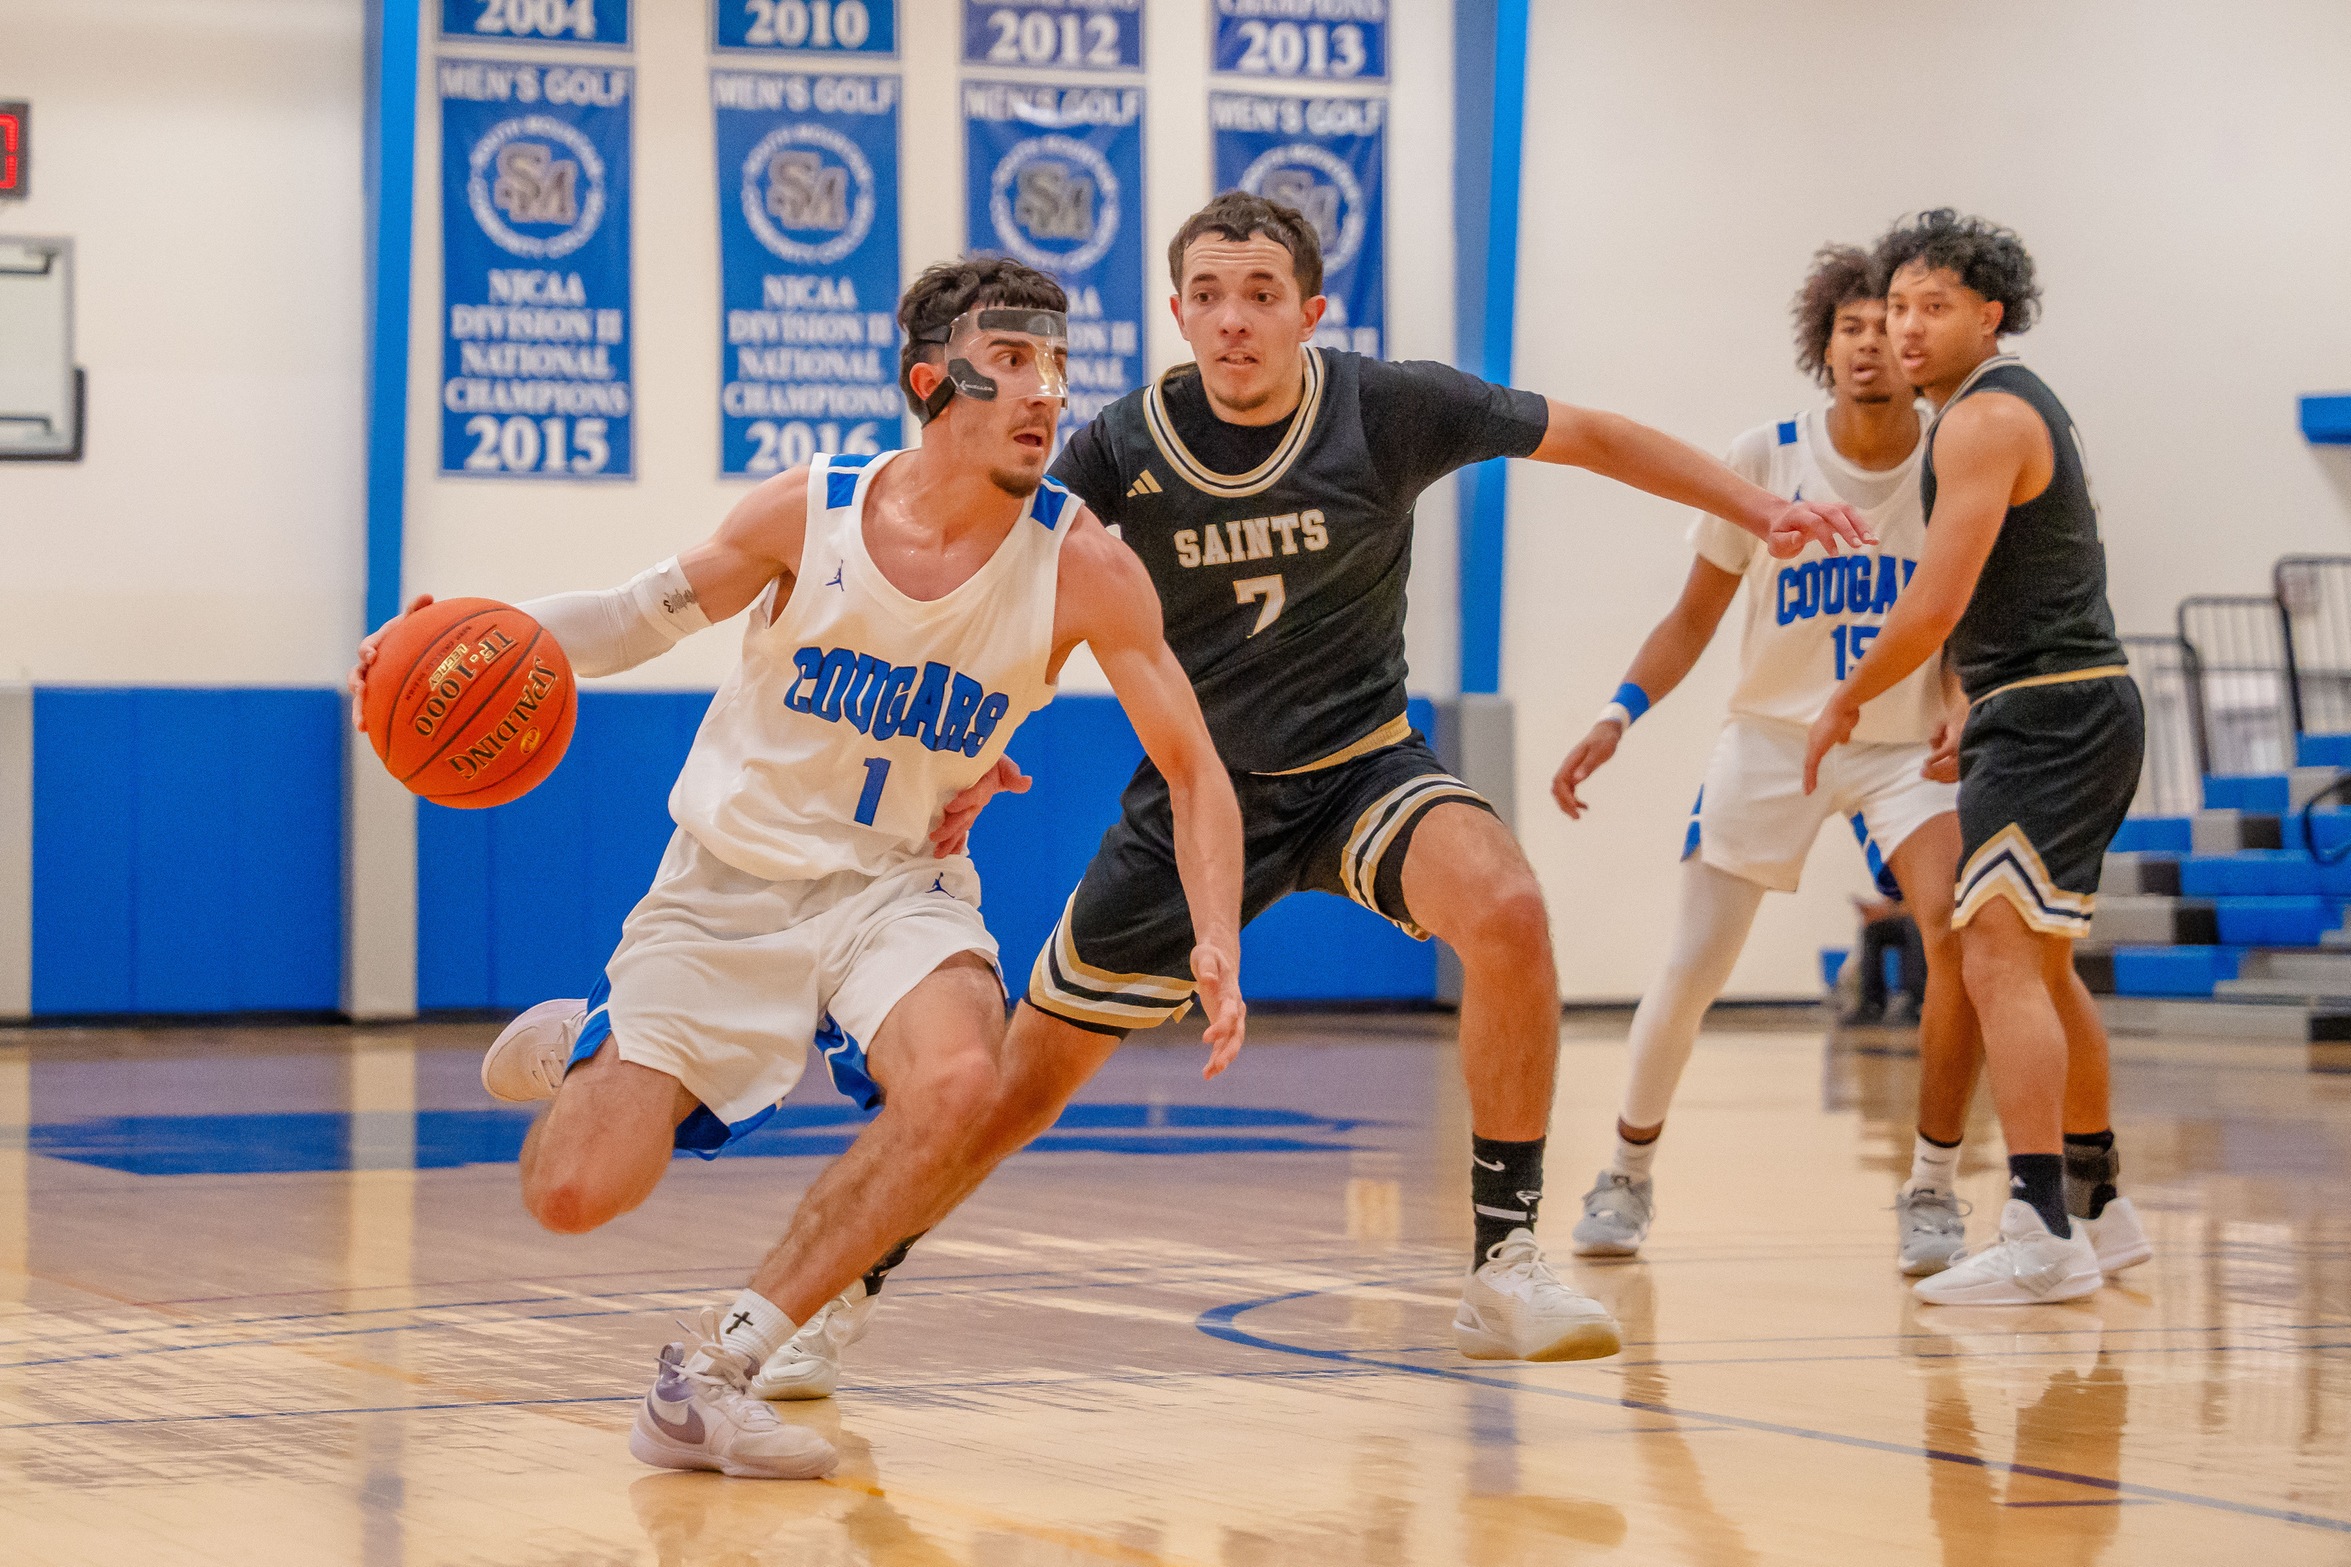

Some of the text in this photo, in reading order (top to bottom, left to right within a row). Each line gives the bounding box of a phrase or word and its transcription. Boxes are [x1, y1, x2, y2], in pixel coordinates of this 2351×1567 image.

[475, 0, 596, 38] 2004
[745, 0, 869, 48] 2010
[987, 10, 1121, 66] 2012
[1238, 21, 1367, 76] 2013
[545, 70, 627, 106] GOLF
[820, 79, 893, 115] GOLF
[452, 304, 594, 341] DIVISION
[728, 310, 865, 345] DIVISION
[461, 341, 616, 379] NATIONAL
[738, 347, 886, 383] NATIONAL
[445, 377, 629, 418] CHAMPIONS
[723, 382, 900, 419] CHAMPIONS
[464, 415, 610, 474] 2015
[746, 420, 880, 473] 2016
[1173, 509, 1329, 568] SAINTS
[1232, 574, 1286, 638] 7
[1775, 554, 1918, 628] COUGA
[447, 655, 558, 780] SPALDING
[783, 646, 1009, 758] COUGARS
[853, 757, 892, 826] 1
